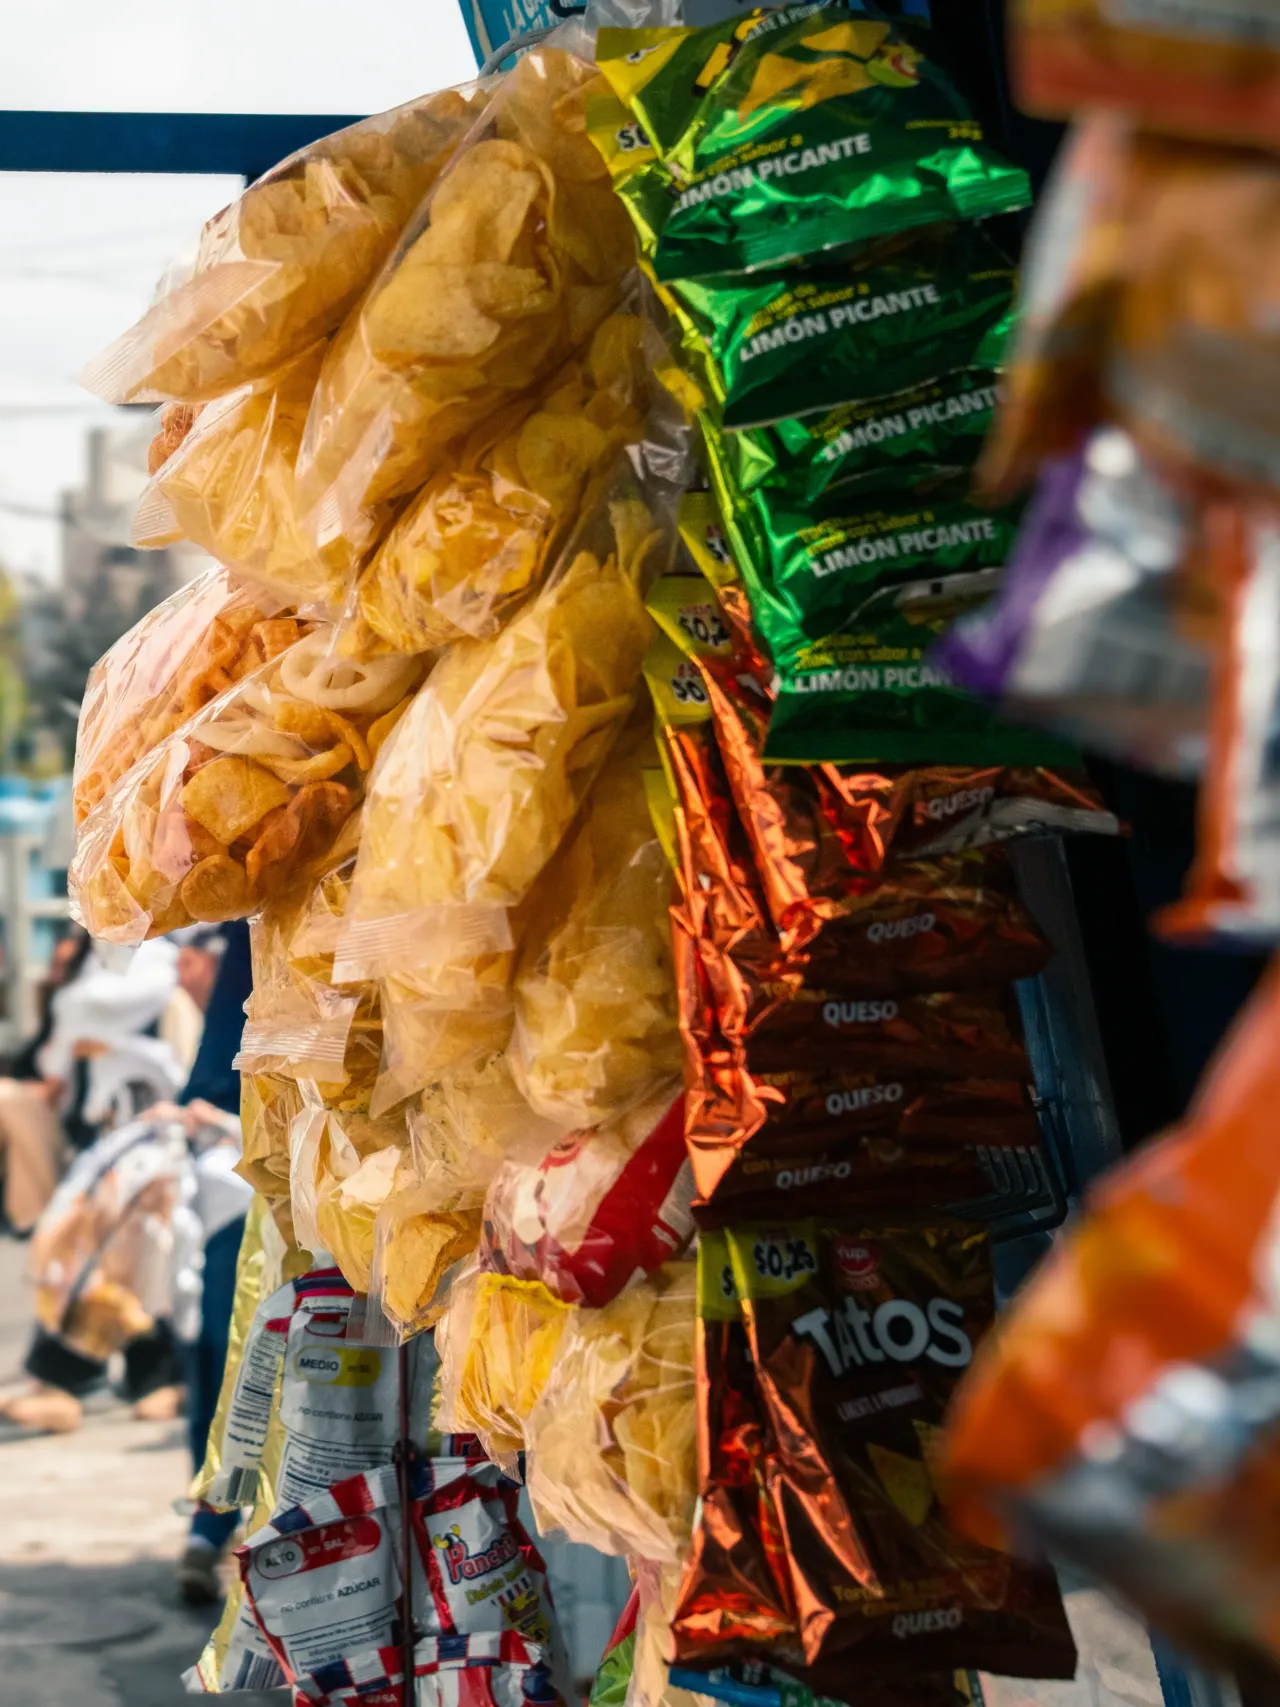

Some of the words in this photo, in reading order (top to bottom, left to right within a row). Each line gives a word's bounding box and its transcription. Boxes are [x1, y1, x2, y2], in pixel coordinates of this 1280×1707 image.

[755, 131, 873, 182] PICANTE
[739, 312, 828, 363] LIMÓN
[828, 282, 942, 330] PICANTE
[822, 413, 907, 462] LIMÓN
[811, 533, 899, 579] LIMÓN
[898, 517, 997, 555] PICANTE
[795, 664, 880, 693] LIMÓN
[866, 911, 937, 944] QUESO
[822, 1000, 900, 1029] QUESO
[825, 1082, 904, 1116] QUESO
[775, 1160, 852, 1190] QUESO
[299, 1357, 340, 1372] MEDIO
[265, 1551, 297, 1569] ALTO
[295, 1592, 335, 1610] contiene
[337, 1576, 381, 1599] AZÚCAR
[891, 1603, 963, 1640] QUESO
